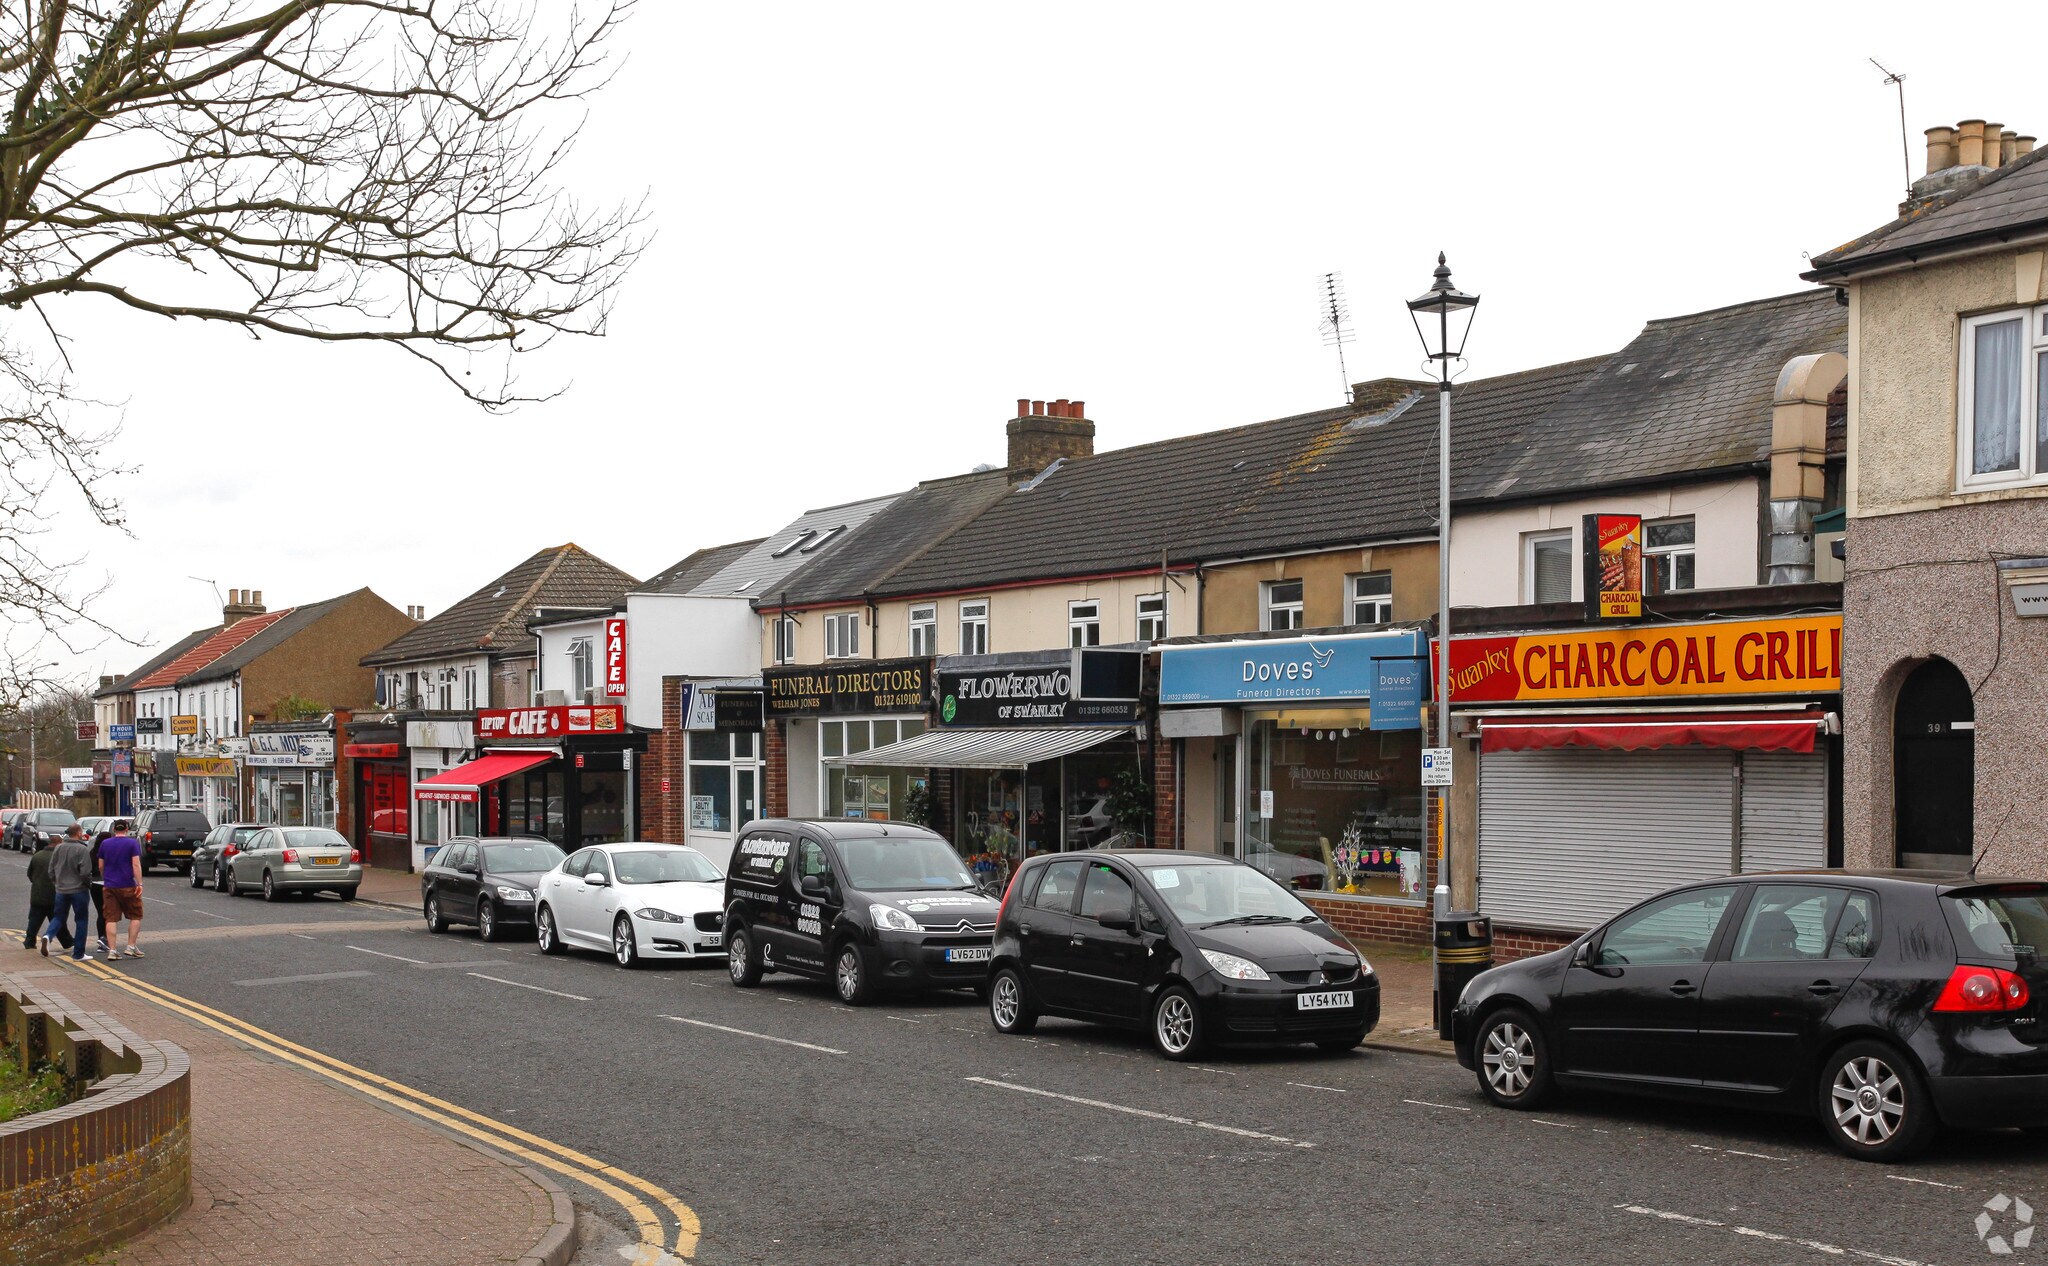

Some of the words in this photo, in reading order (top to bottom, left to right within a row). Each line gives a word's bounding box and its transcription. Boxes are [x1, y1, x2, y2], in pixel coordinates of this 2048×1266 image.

[1600, 594, 1639, 603] CHARCOAL
[1610, 605, 1630, 614] GRILL
[608, 622, 622, 682] CAFE
[1523, 636, 1726, 690] CHARCOAL
[1734, 628, 1841, 682] GRILL
[1243, 660, 1314, 682] Doves
[772, 675, 832, 696] FUNERAL
[837, 670, 922, 693] DIRECTORS
[958, 670, 1071, 699] FLOWERWO
[1380, 676, 1411, 685] Doves
[608, 683, 624, 692] OPEN
[1236, 689, 1272, 698] Funeral
[1276, 686, 1321, 696] Directors
[772, 699, 799, 709] WELHAM
[800, 698, 820, 708] JONES
[874, 694, 894, 706] 01322
[896, 693, 921, 705] 619100
[998, 705, 1012, 718] OF
[1014, 702, 1067, 718] SWANLEY
[1078, 705, 1100, 714] 01322
[1102, 704, 1128, 714] 660552
[509, 710, 548, 734] CAFE
[1425, 756, 1431, 767] P
[1300, 768, 1331, 780] DOVES
[1334, 768, 1380, 780] FUNERALS
[760, 892, 779, 903] OCCASIONS
[709, 936, 719, 944] S9
[951, 950, 974, 960] LV62
[1302, 994, 1329, 1007] LY54
[1332, 993, 1350, 1005] KTX
